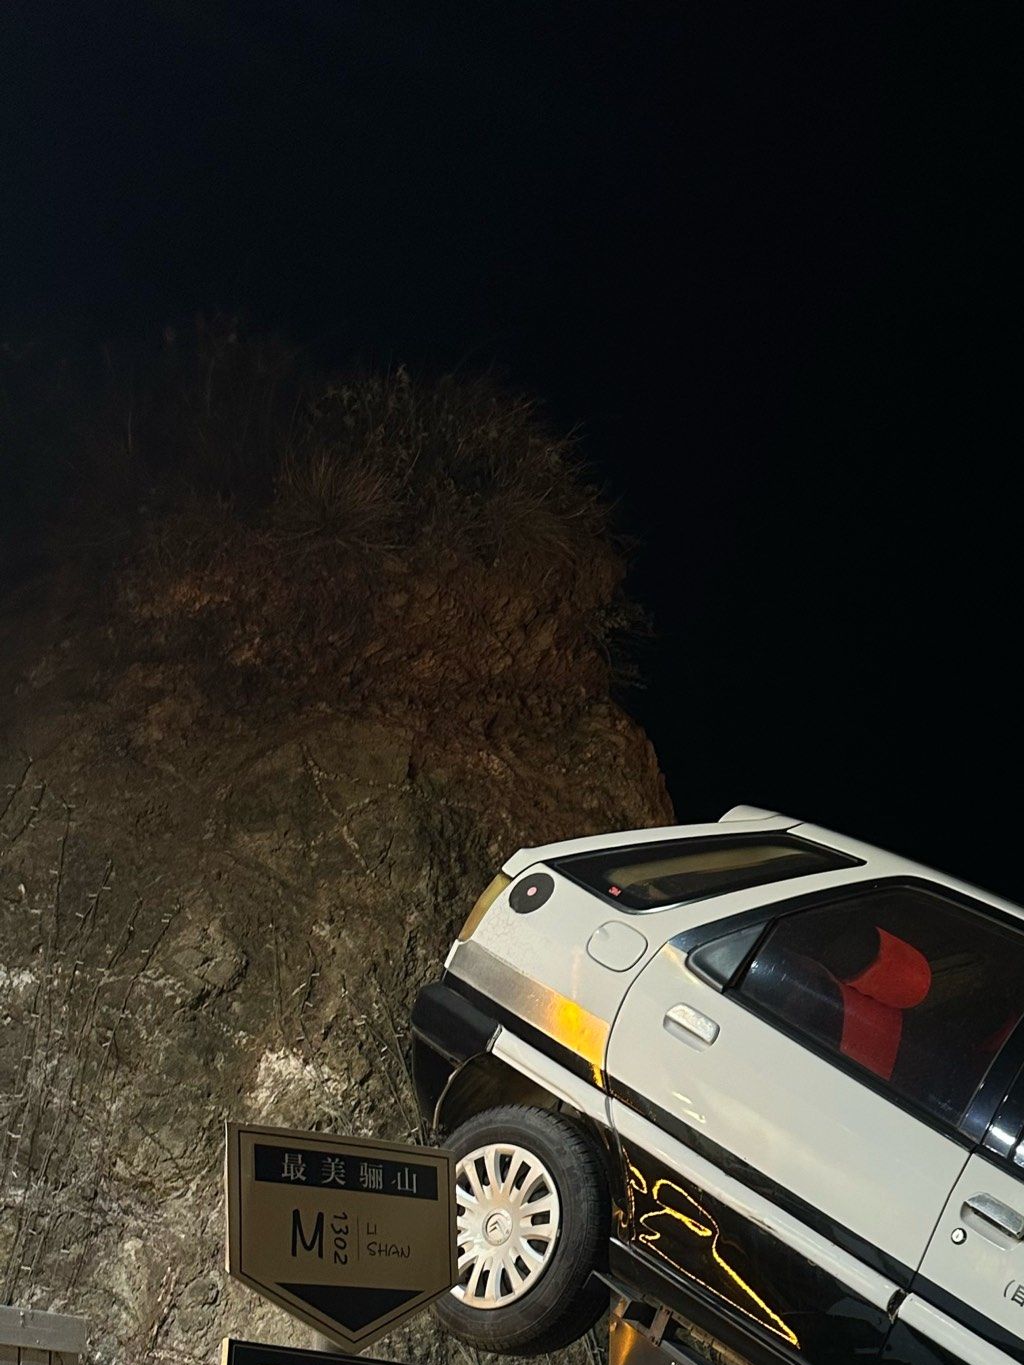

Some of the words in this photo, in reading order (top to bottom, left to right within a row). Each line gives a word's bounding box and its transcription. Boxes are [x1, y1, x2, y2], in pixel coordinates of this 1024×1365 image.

[281, 1152, 417, 1194] 最美骊山
[290, 1208, 325, 1260] M
[331, 1211, 349, 1265] 1302
[366, 1222, 377, 1236] LI
[366, 1241, 411, 1259] SHAN
